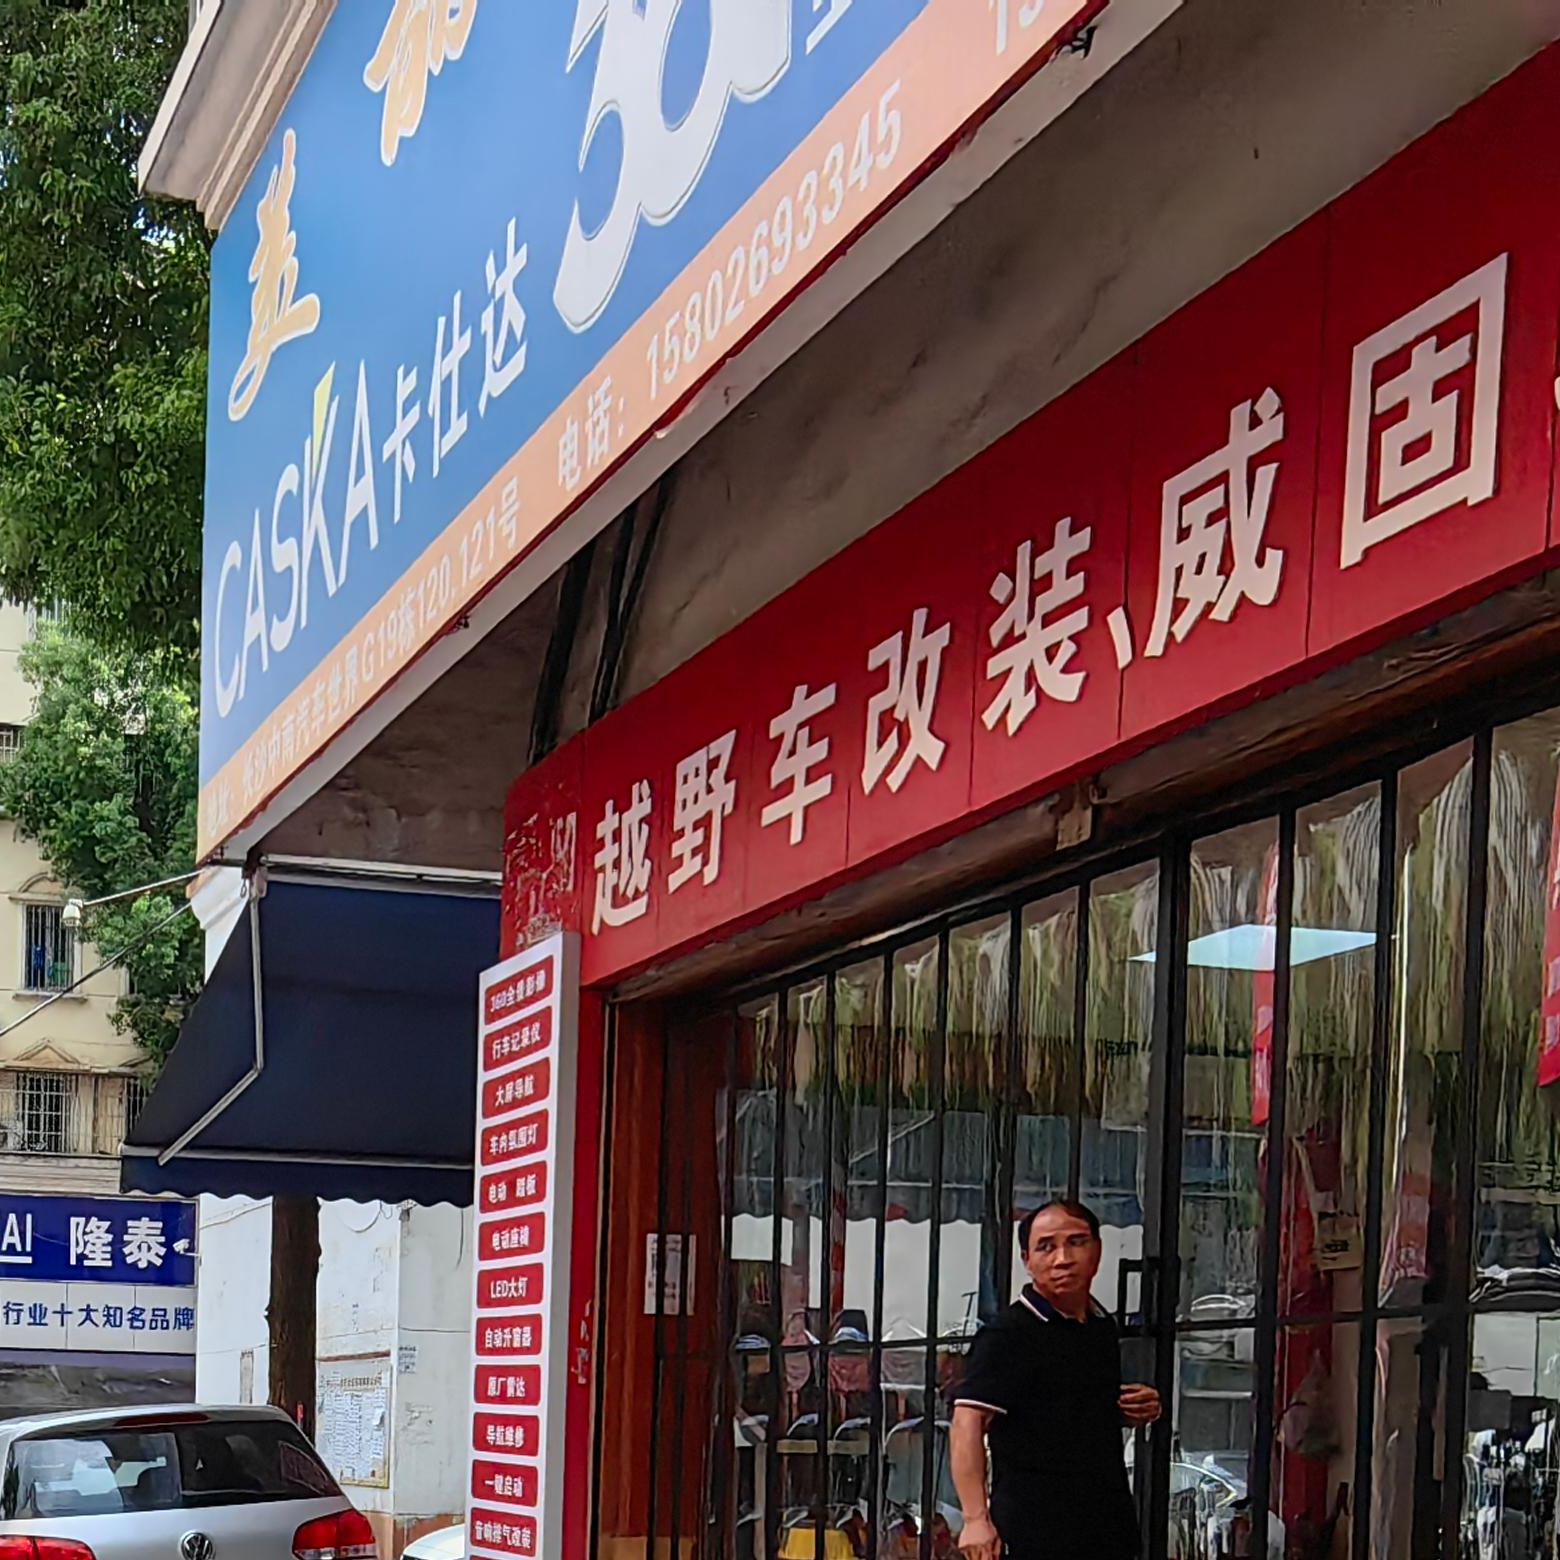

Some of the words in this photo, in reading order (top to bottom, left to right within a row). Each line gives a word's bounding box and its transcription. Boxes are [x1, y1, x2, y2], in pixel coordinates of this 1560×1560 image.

[646, 79, 902, 400] 15802693345
[214, 358, 379, 719] CASKA
[382, 216, 528, 524] 卡仕达
[492, 1021, 541, 1060] 行车记录仪
[495, 1075, 535, 1107] 大屏导航
[69, 1216, 167, 1269] 隆泰
[490, 1277, 528, 1299] LED大灯
[2, 1302, 196, 1332] 行业十大知名品牌
[484, 1475, 524, 1498] 一键启动
